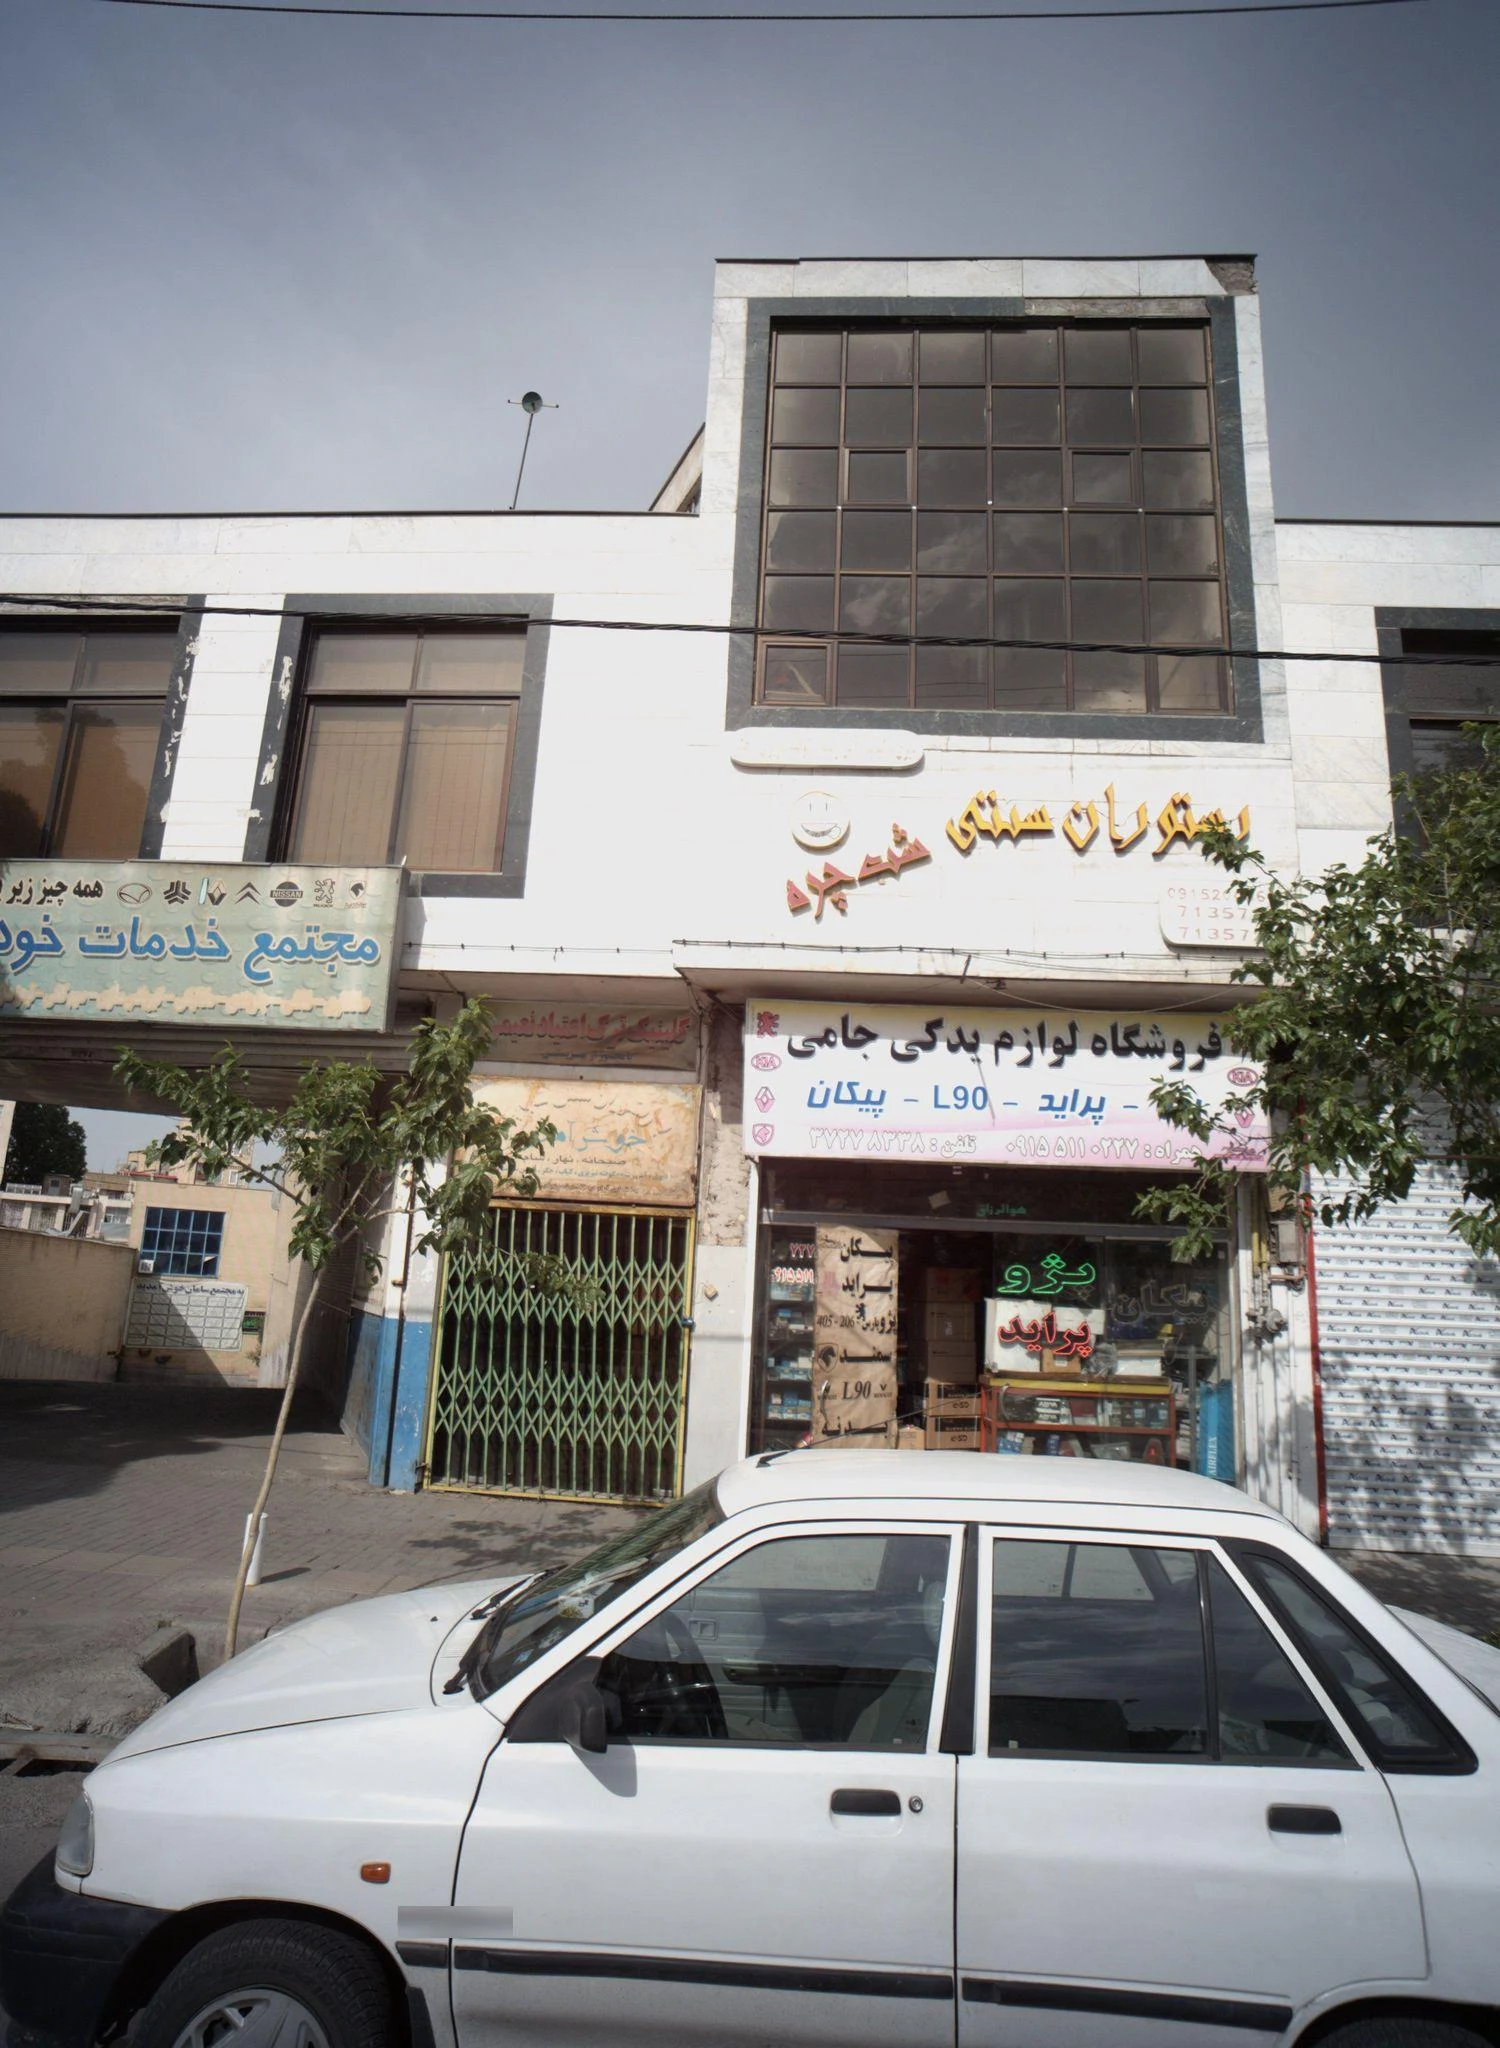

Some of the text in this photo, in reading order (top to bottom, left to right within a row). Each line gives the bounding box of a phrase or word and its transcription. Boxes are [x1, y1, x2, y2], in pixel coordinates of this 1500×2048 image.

[36, 878, 68, 906] چیز
[73, 880, 103, 898] همه
[271, 890, 303, 898] NISSAN
[78, 915, 231, 958] خدمات
[243, 924, 380, 982] مجتمع
[787, 1013, 1222, 1071] فروشگاه لوازم یدکی جامی
[806, 1080, 887, 1119] پیکان
[933, 1085, 989, 1111] L90
[1038, 1088, 1107, 1125] پراید
[840, 1236, 893, 1267] پیکان
[841, 1271, 893, 1300] پراید
[997, 1311, 1092, 1358] پراید
[839, 1345, 892, 1363] سمند
[842, 1381, 872, 1400] L90
